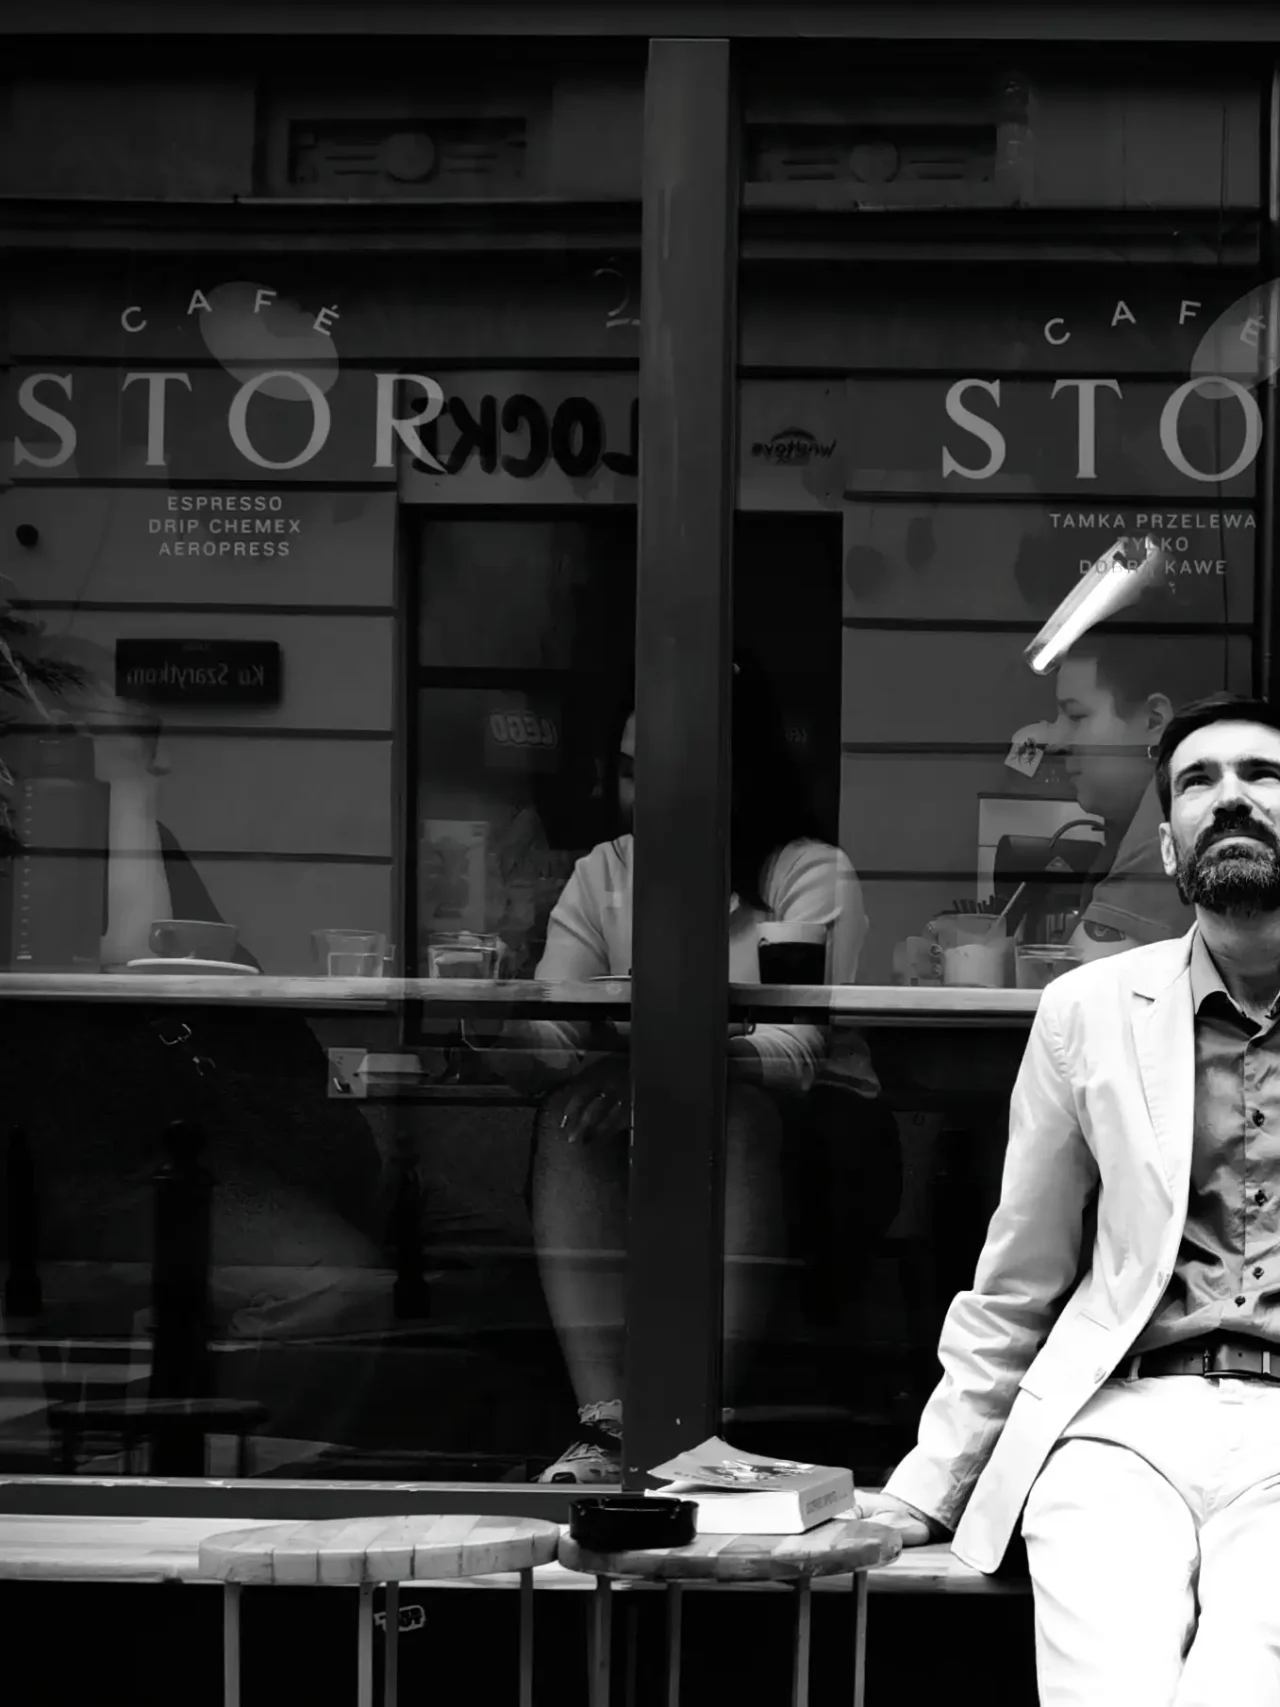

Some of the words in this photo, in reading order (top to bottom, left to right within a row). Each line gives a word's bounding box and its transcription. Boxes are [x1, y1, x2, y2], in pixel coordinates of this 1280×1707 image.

[13, 370, 448, 474] STOR
[167, 496, 283, 512] ESPRESSO
[148, 519, 199, 534] DRIP
[208, 518, 302, 535] CHEMEX
[1049, 513, 1126, 529] TAMKA
[1136, 513, 1257, 529] PRZELEWA
[158, 541, 291, 557] AEROPRESS
